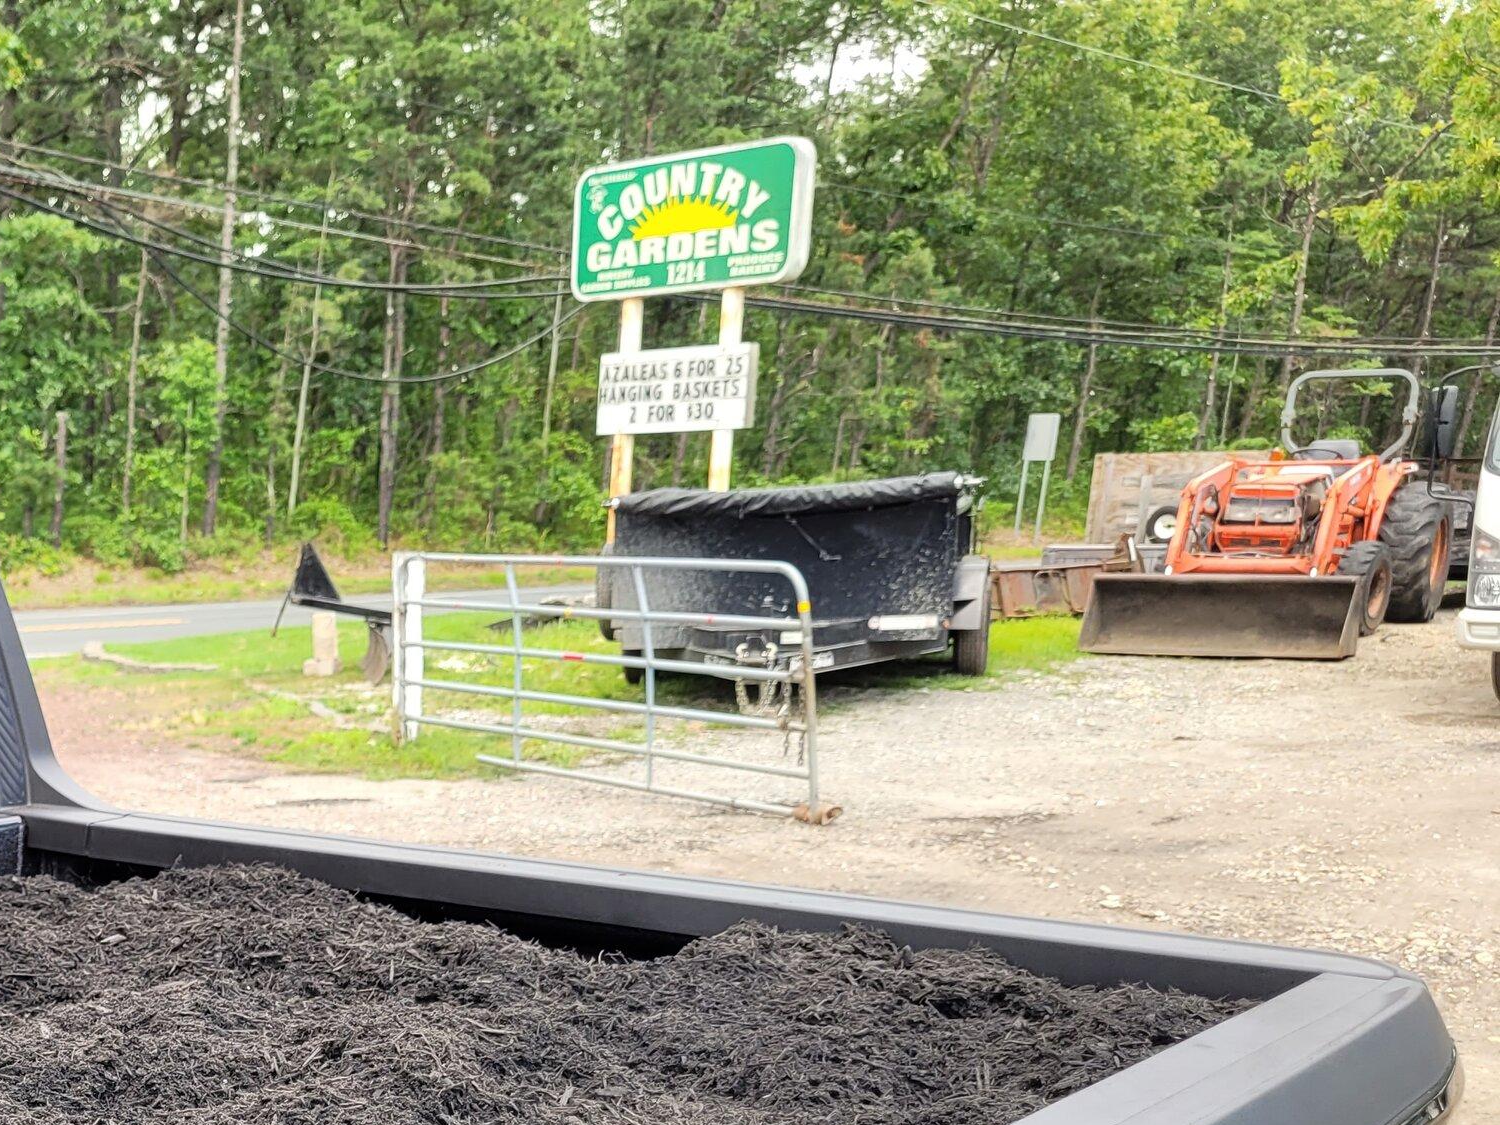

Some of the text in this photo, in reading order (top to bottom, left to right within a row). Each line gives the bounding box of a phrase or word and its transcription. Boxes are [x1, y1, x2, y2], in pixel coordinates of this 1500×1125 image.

[597, 160, 771, 241] COUNTRY
[586, 218, 780, 272] GARDENS
[666, 260, 706, 286] 1214
[602, 357, 743, 383] AZALEAS 6 FOR 25
[599, 379, 740, 405] HANGING BASKETS
[629, 402, 714, 424] 2 FOR $30
